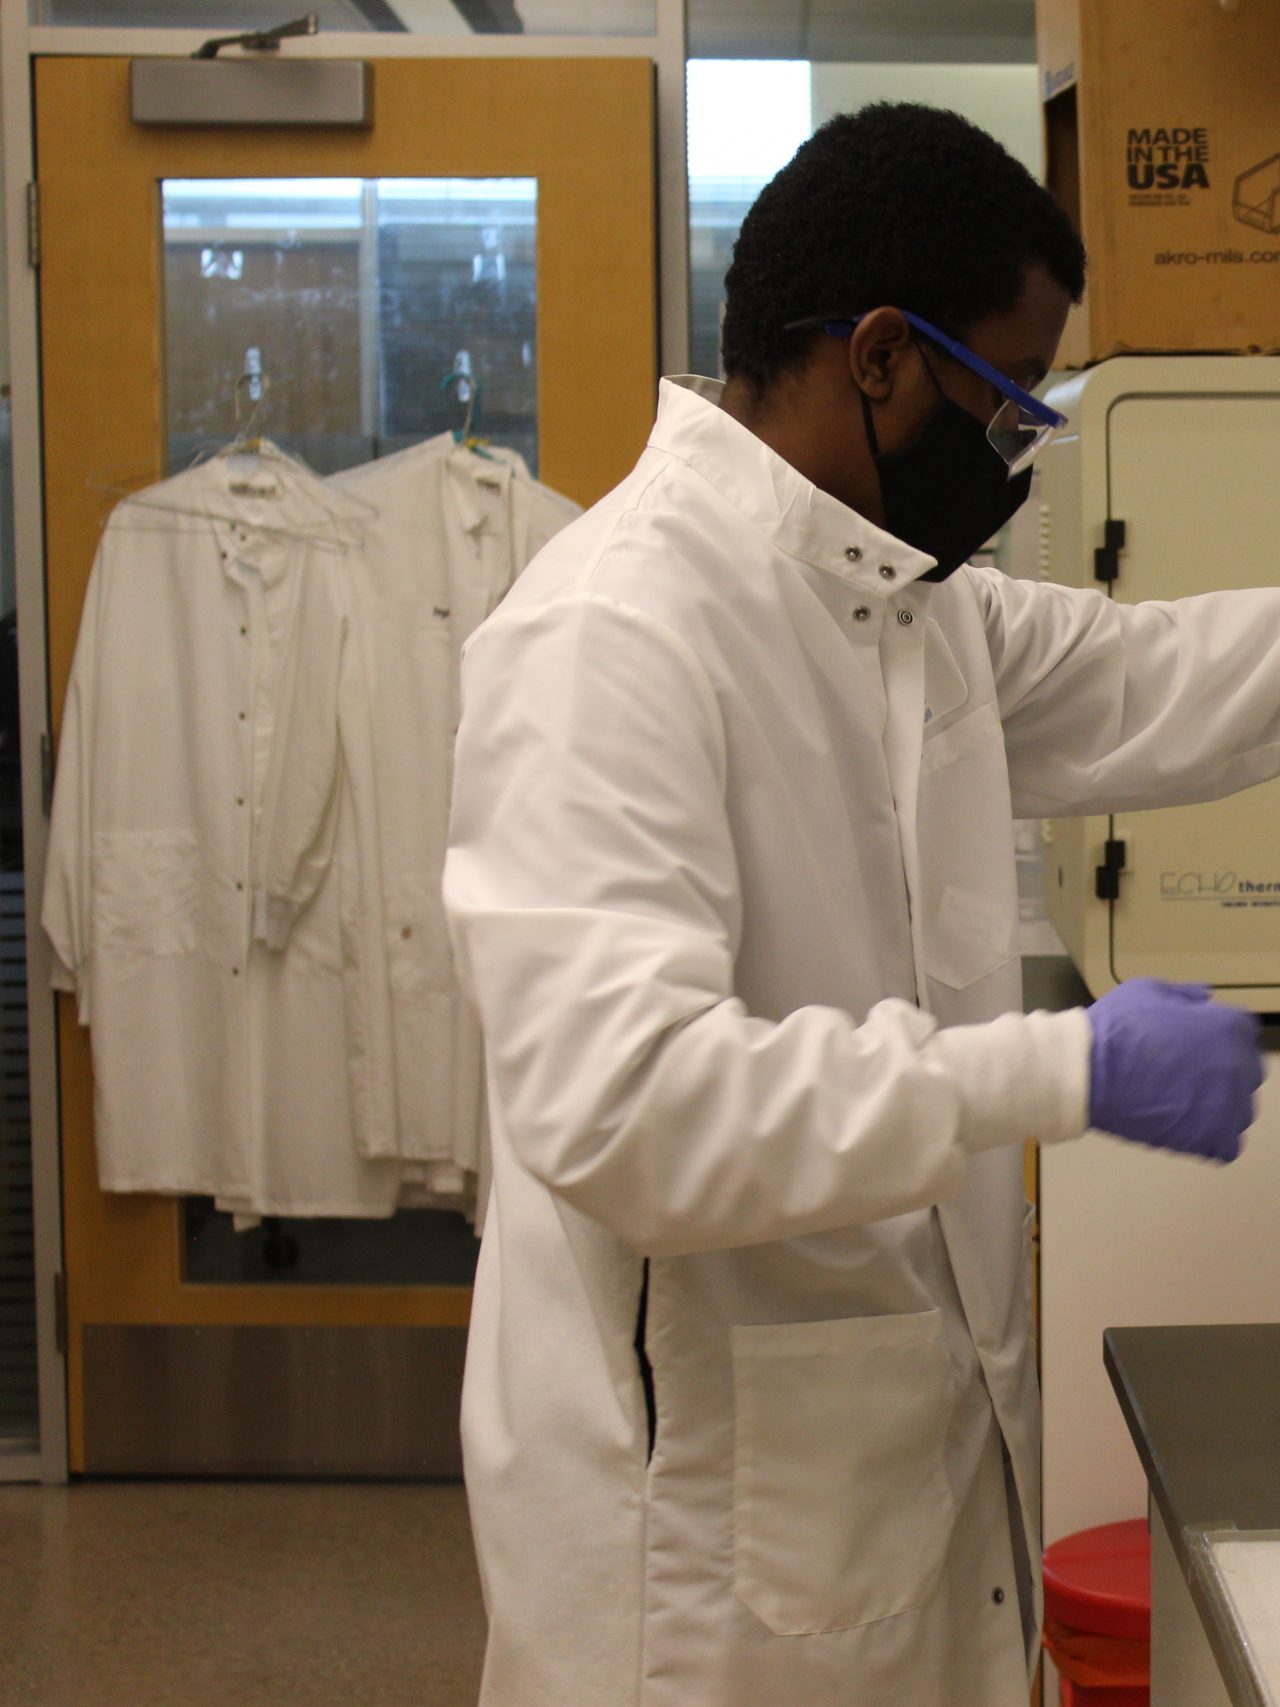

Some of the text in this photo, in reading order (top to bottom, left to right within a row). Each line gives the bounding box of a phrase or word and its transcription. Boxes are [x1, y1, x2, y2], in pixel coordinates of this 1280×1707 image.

[1127, 128, 1207, 145] MADE
[1127, 145, 1209, 163] IN THE
[1127, 163, 1210, 190] USA
